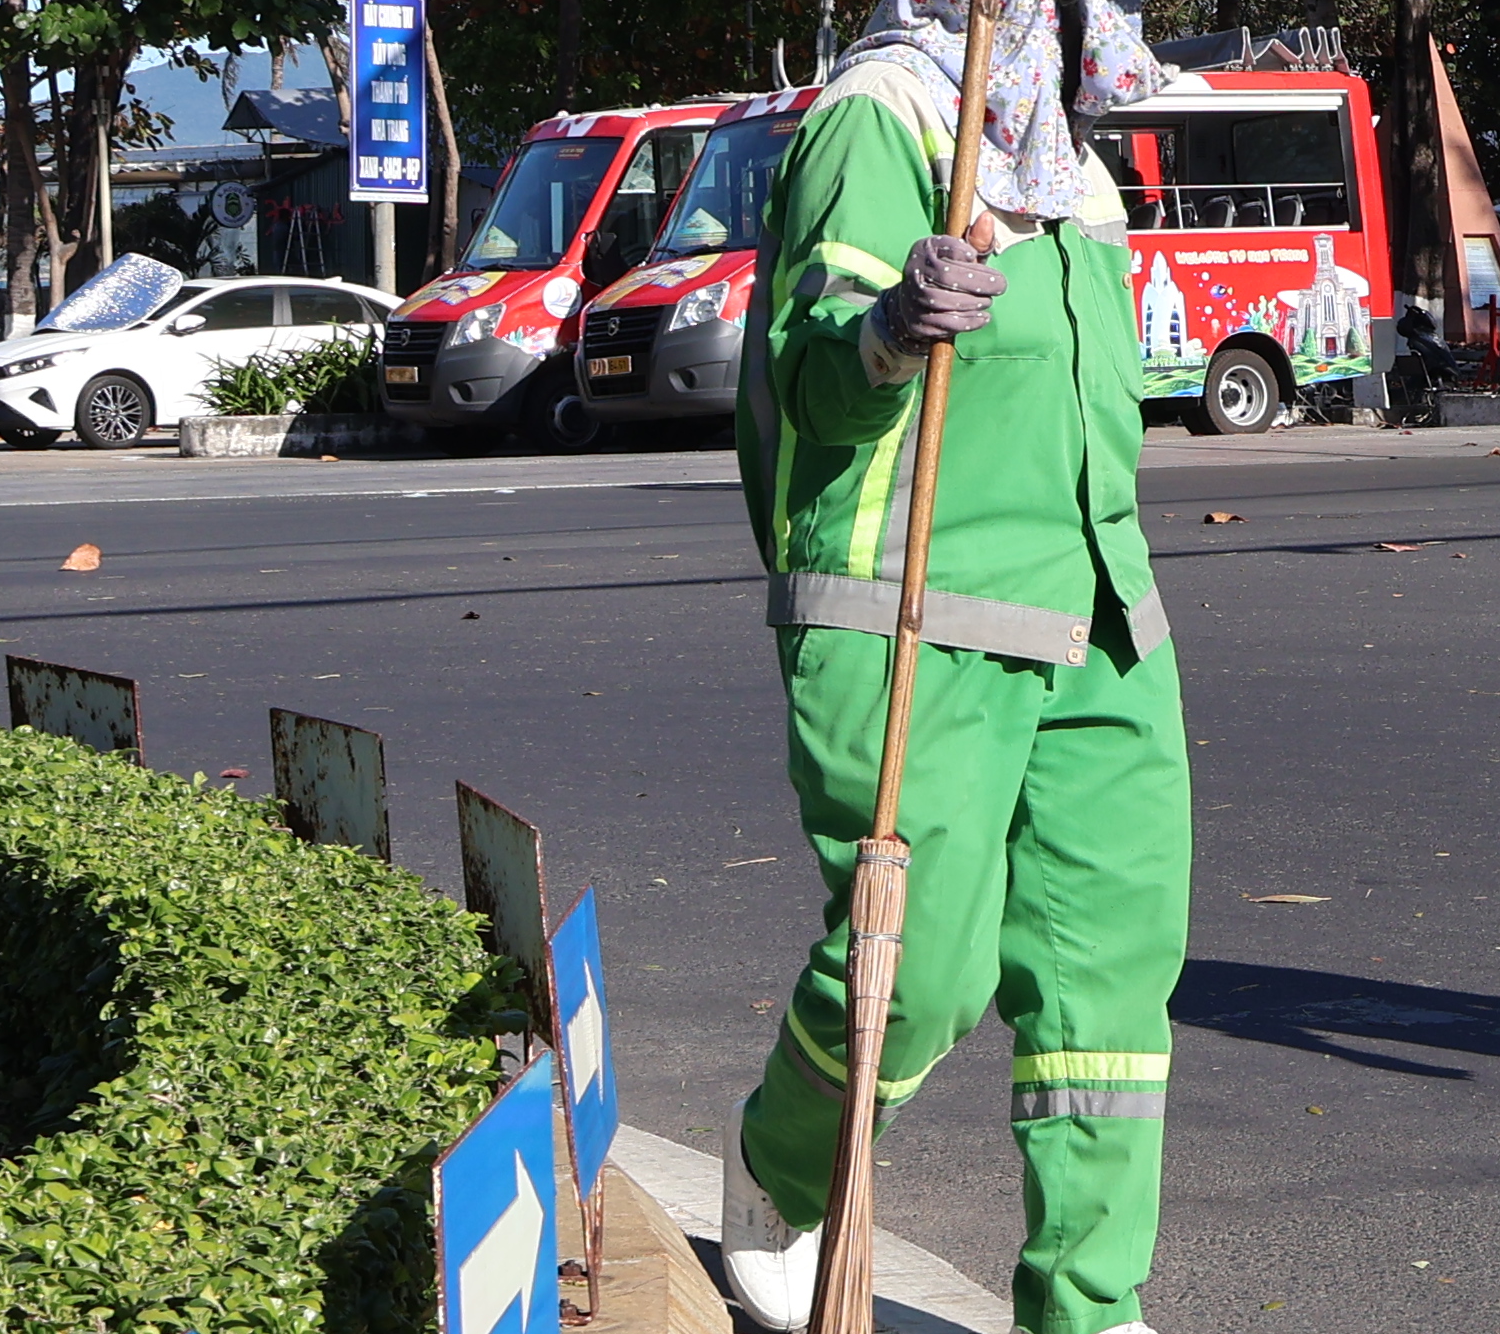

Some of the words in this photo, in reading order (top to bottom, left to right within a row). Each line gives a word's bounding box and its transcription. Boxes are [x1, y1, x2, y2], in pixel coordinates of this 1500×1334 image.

[394, 74, 408, 104] PHỐ
[372, 119, 387, 141] NHA
[387, 119, 409, 143] TRANG
[359, 156, 379, 179] XANH
[383, 156, 402, 185] SẠCH
[1174, 250, 1229, 265] WELCOME
[1229, 249, 1246, 264] TO
